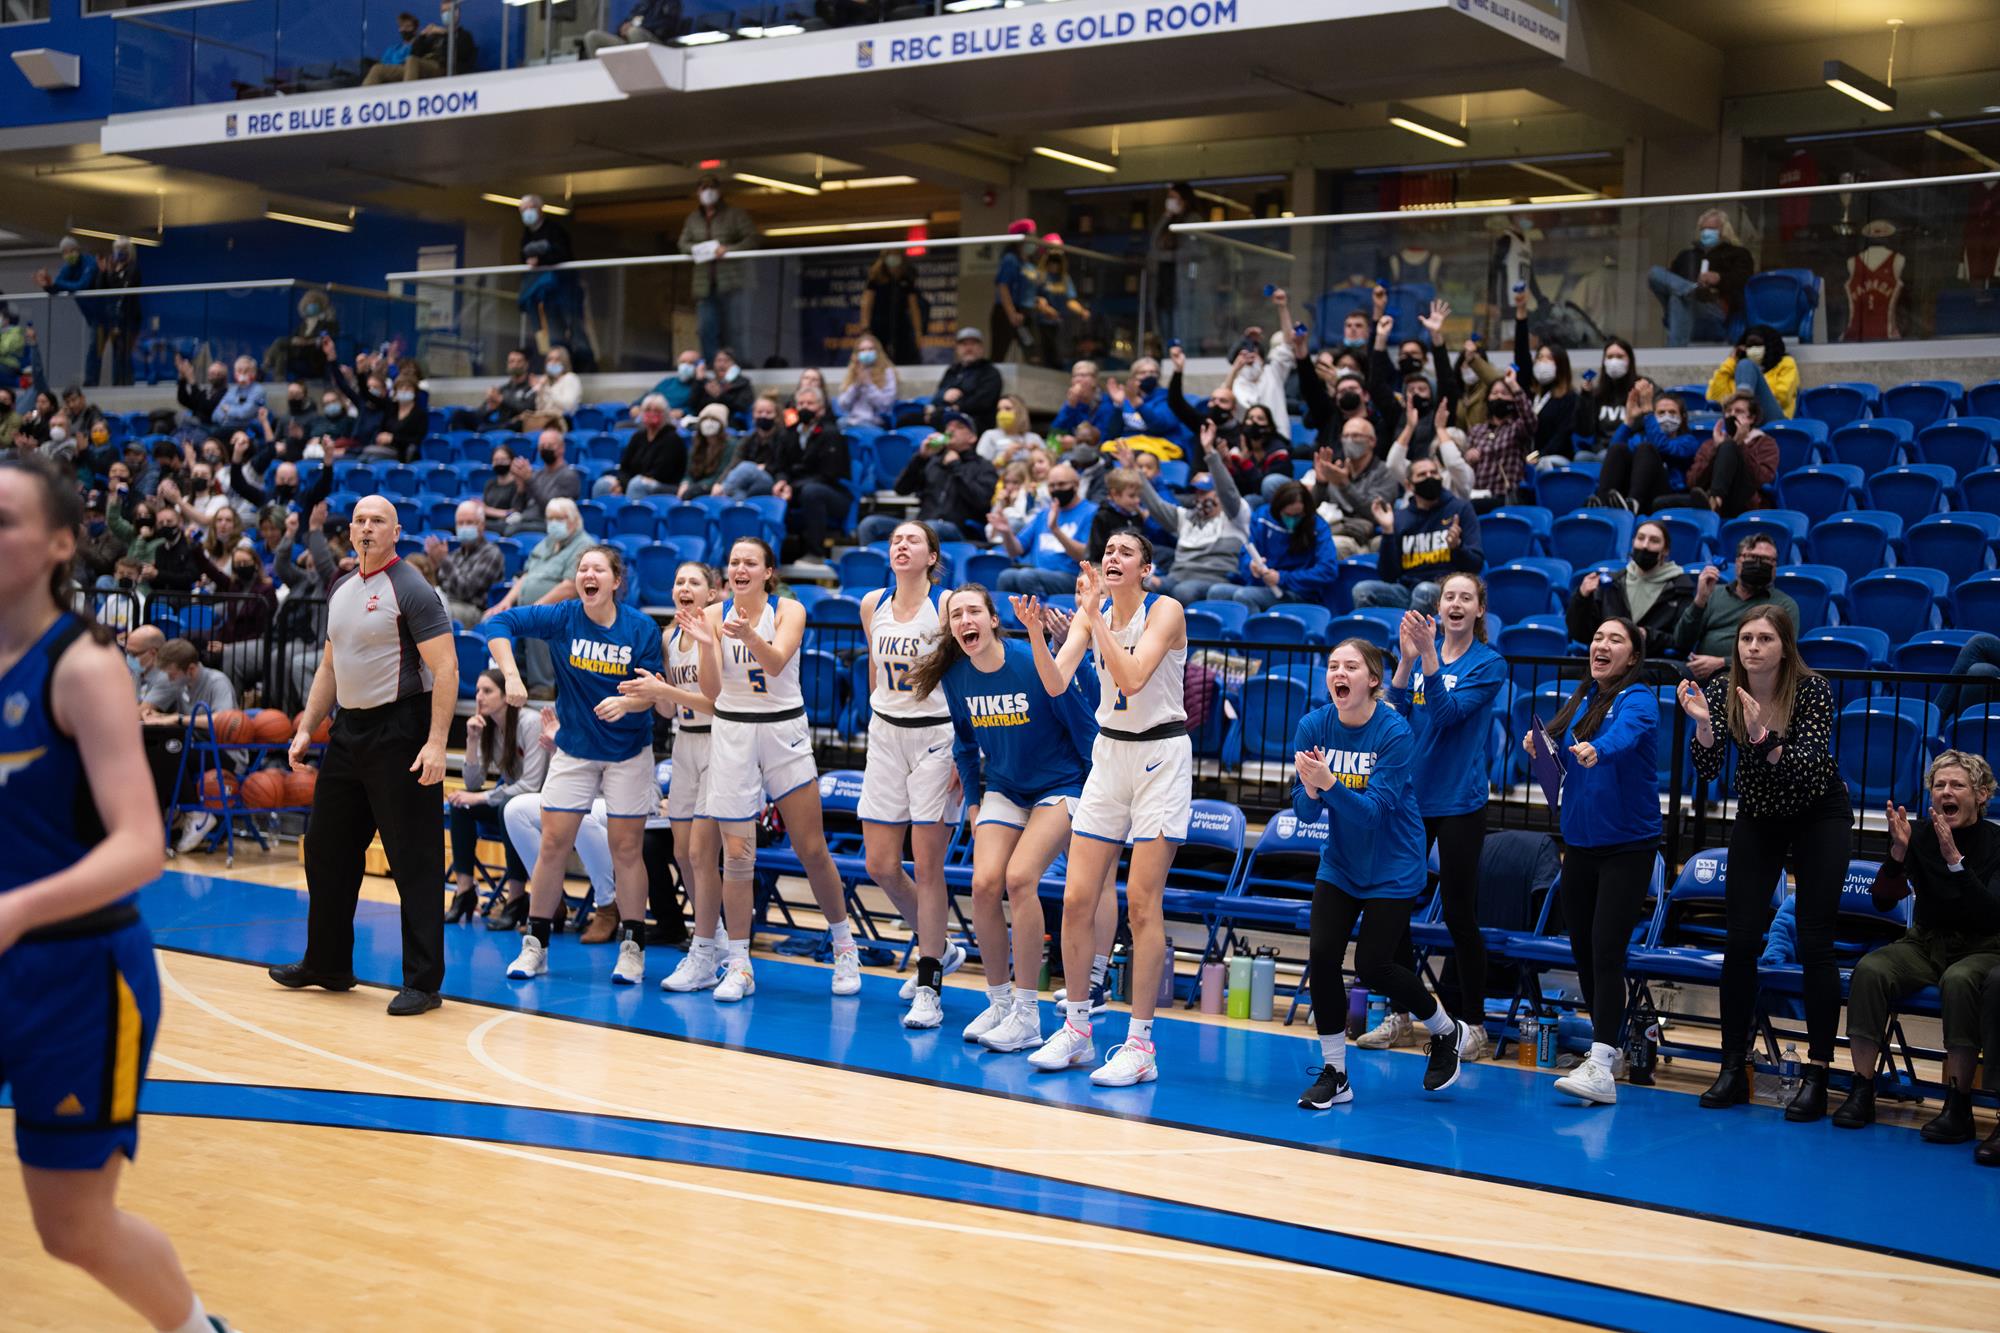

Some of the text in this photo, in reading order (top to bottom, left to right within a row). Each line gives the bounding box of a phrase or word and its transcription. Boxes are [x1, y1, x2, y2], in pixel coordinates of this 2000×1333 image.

[890, 0, 1237, 63] RBC BLUE & GOLD ROOM
[1490, 2, 1510, 21] BLUE
[1517, 14, 1537, 33] GOLD
[1538, 24, 1560, 42] ROOM
[248, 90, 478, 134] RBC BLUE & GOLD ROOM
[1599, 405, 1626, 421] UVI
[1402, 529, 1449, 554] VIKES
[571, 638, 632, 665] VIKES
[879, 636, 919, 657] VIKES
[569, 654, 628, 676] BASKETBALL
[672, 664, 698, 685] VIKES
[747, 668, 768, 694] 5
[884, 661, 914, 693] 12
[965, 692, 1029, 716] VIKES
[970, 711, 1031, 728] BASKETBALL
[1191, 820, 1229, 831] of Victoria
[1194, 810, 1232, 824] University
[1297, 829, 1329, 839] of Victo
[1842, 884, 1853, 893] of
